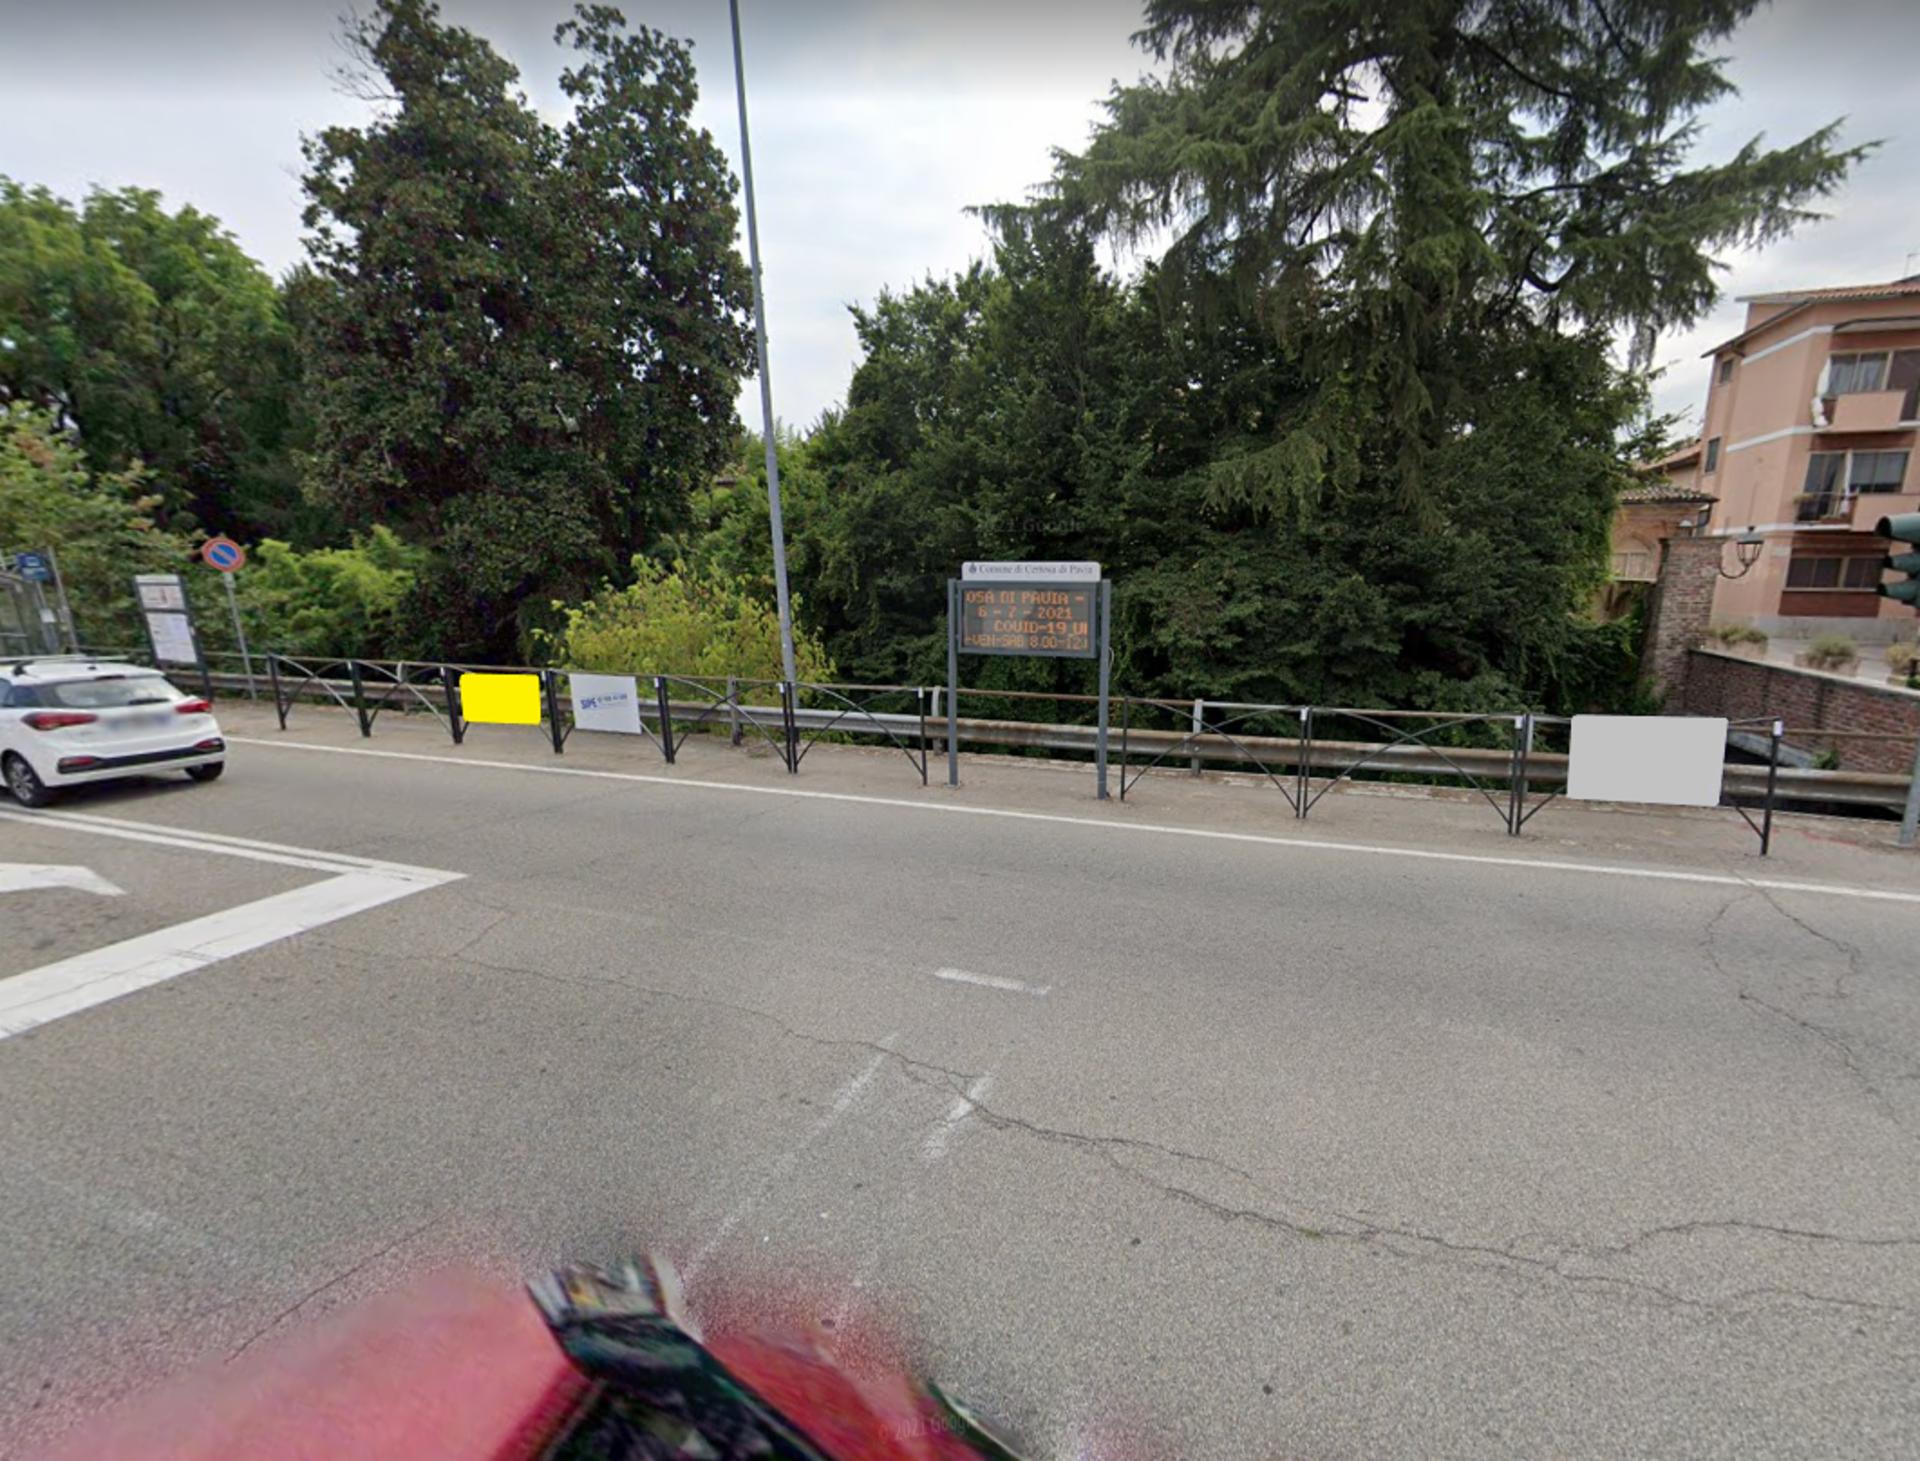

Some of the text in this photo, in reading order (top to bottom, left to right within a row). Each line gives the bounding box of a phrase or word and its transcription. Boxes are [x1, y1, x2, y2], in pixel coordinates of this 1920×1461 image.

[978, 564, 1012, 575] Comune
[1025, 564, 1057, 575] Certosa
[1070, 564, 1094, 575] Pavia
